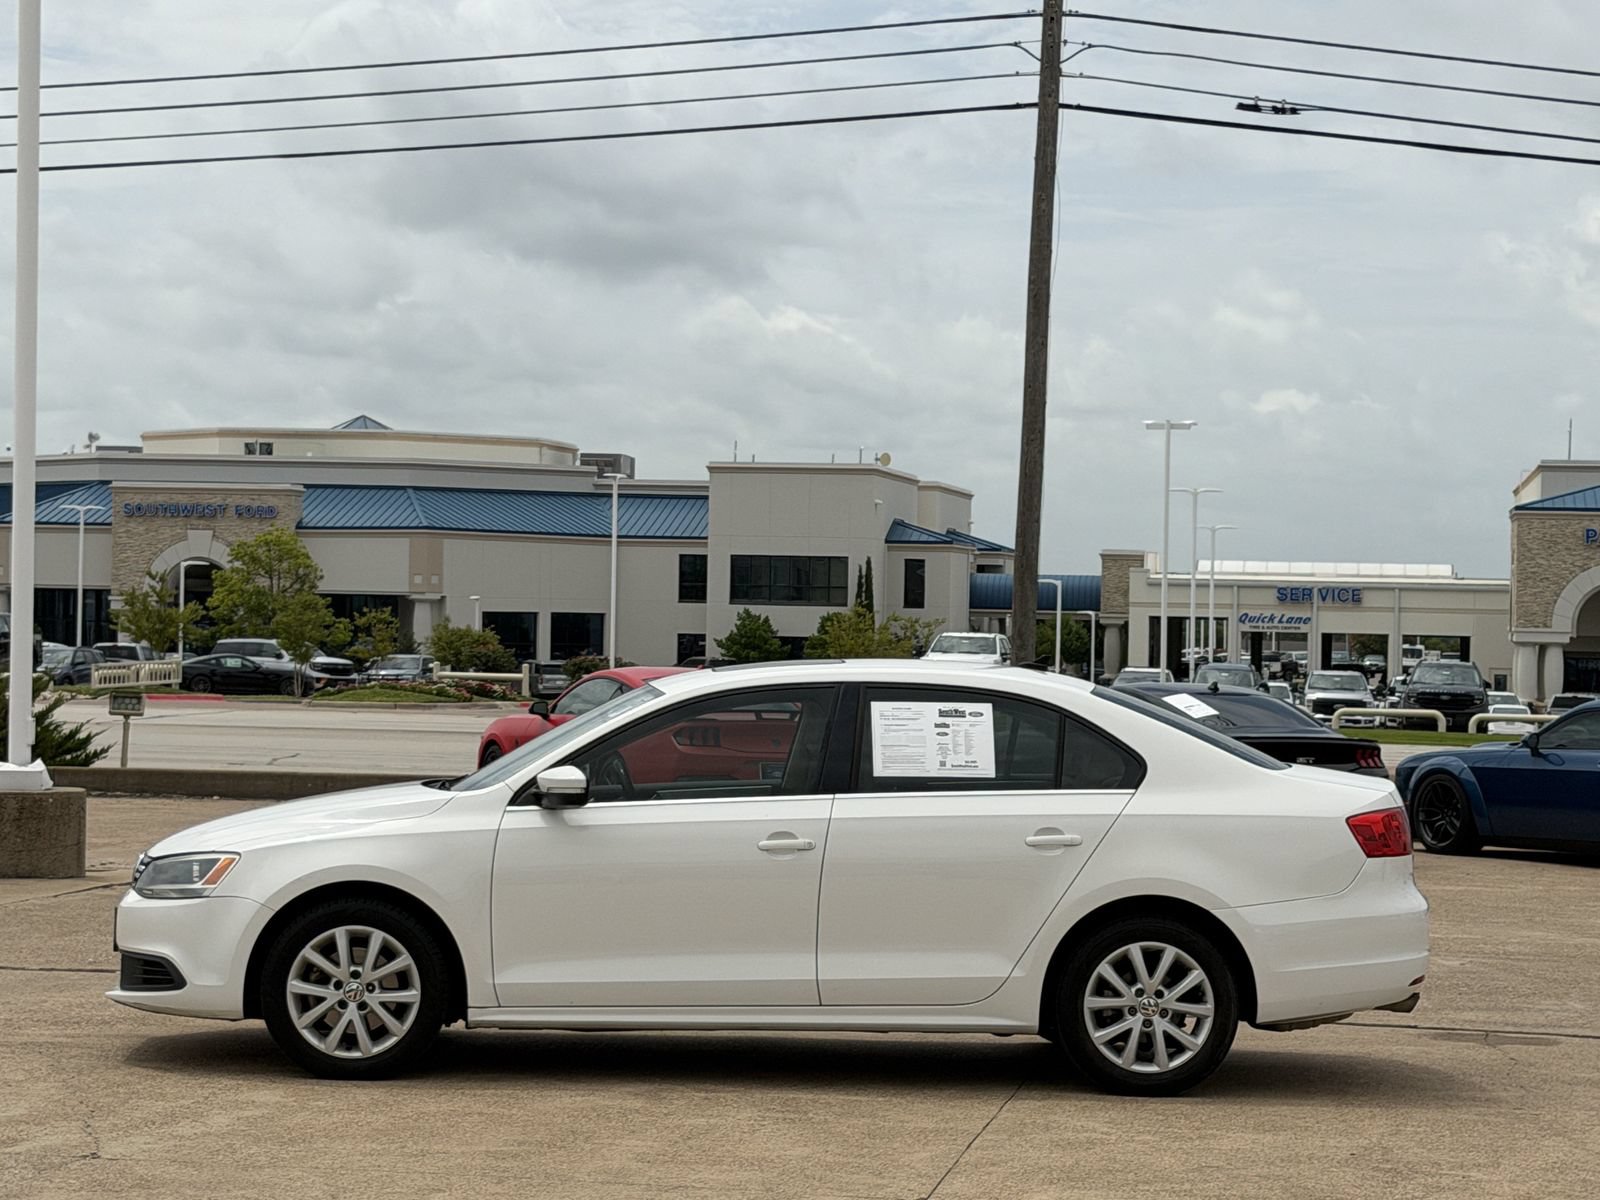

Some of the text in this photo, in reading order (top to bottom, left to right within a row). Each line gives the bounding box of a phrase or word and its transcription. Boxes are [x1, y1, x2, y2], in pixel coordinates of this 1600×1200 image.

[122, 502, 279, 518] SOUTHWEST FORD
[1277, 587, 1361, 603] SERVICE
[1239, 612, 1311, 624] Quick Lane
